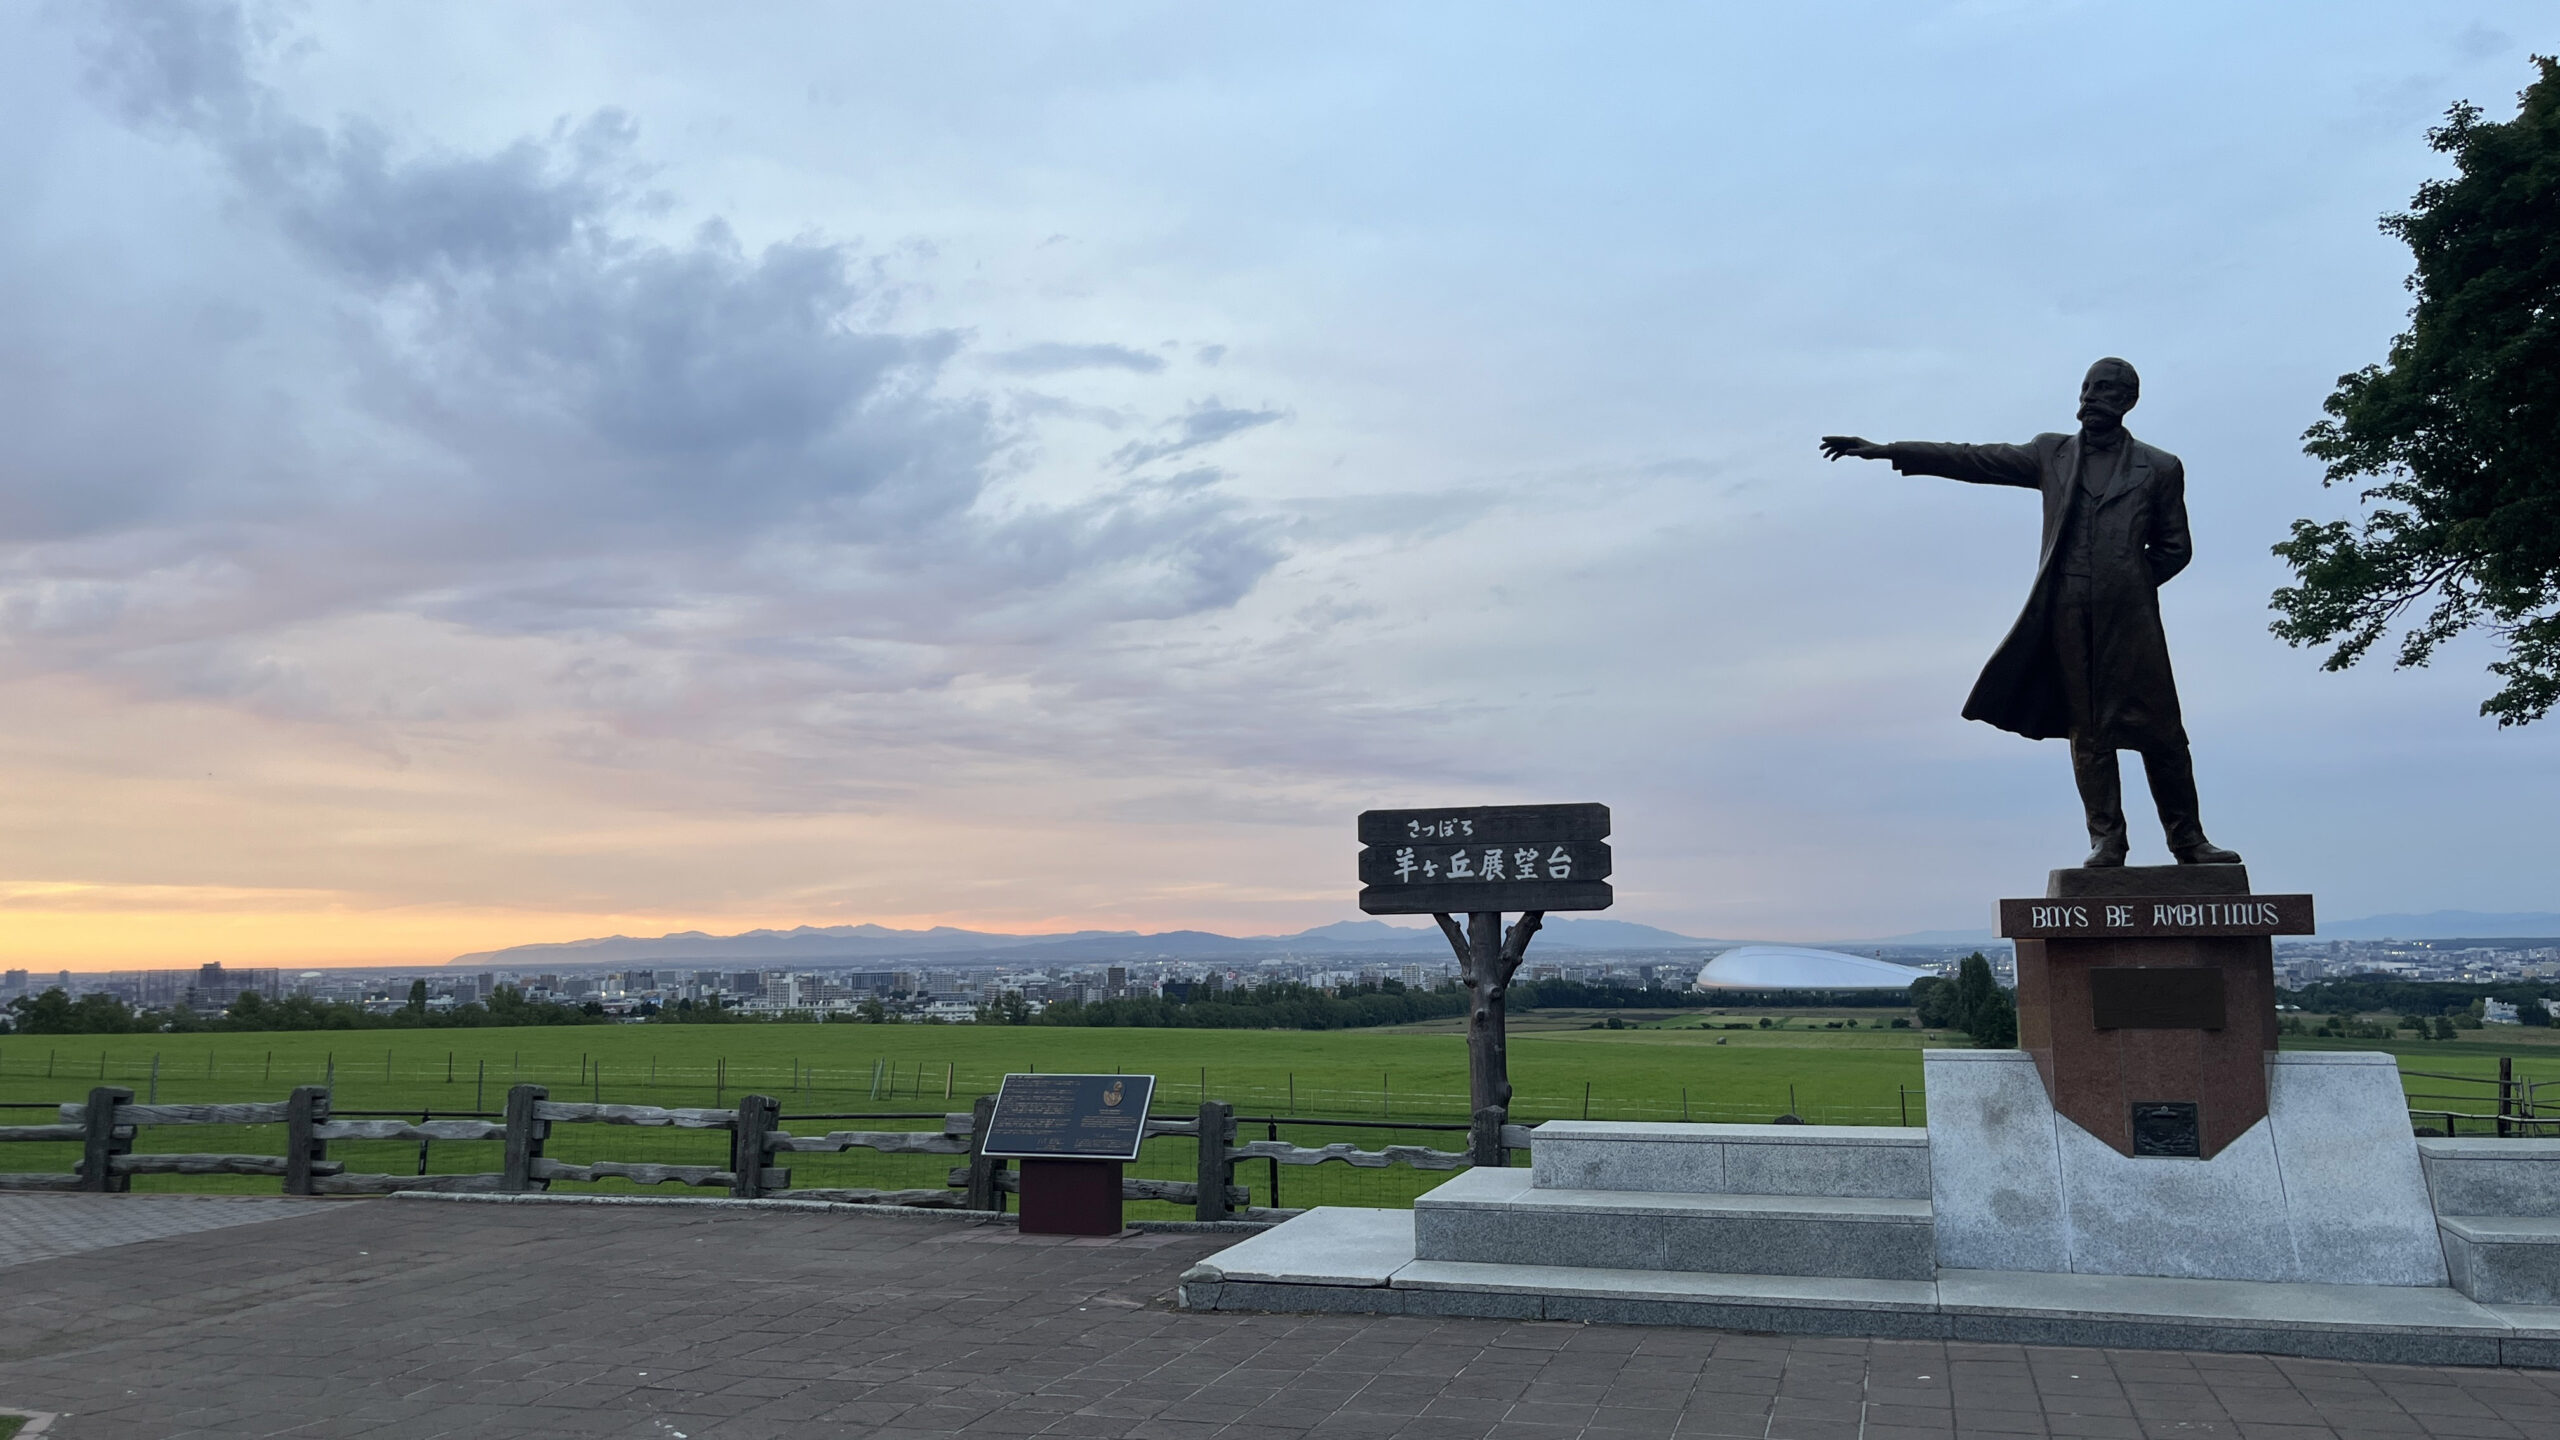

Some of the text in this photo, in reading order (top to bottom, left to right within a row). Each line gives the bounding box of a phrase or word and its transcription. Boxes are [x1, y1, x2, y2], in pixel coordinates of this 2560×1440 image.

[1407, 817, 1474, 838] さっぽろ
[1393, 846, 1573, 883] 羊ヶ丘展望台
[2031, 903, 2279, 928] BOYS BE AMBITIOUS
